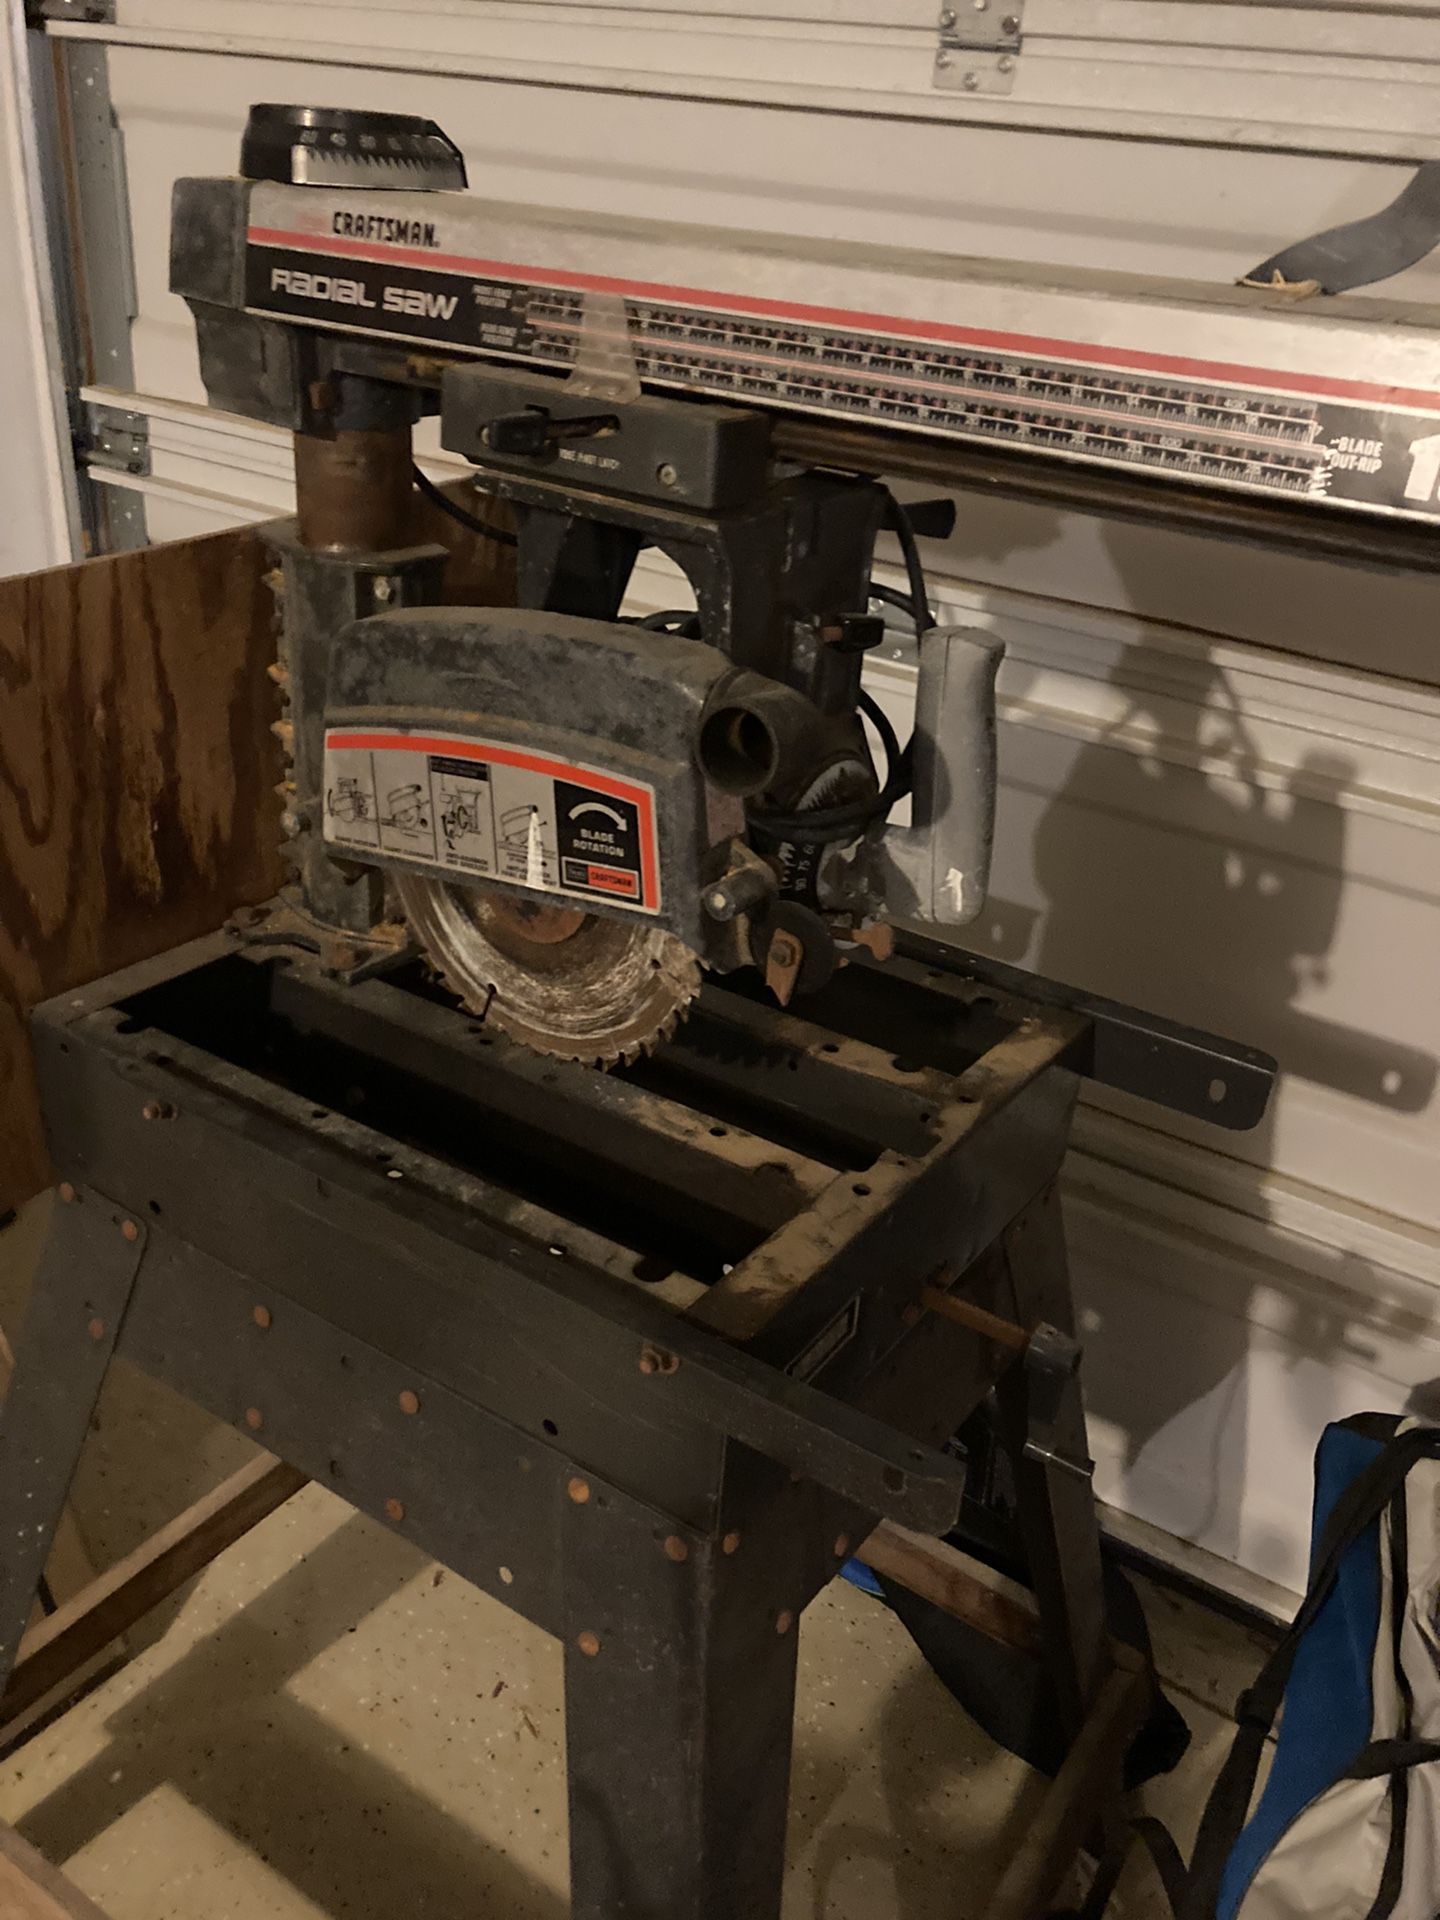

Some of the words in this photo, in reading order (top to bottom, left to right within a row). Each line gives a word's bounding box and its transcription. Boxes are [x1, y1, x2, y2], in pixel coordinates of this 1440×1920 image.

[1337, 435, 1384, 458] BLADE
[1330, 453, 1383, 475] OUT-RIP
[580, 828, 615, 844] BLADE
[572, 838, 625, 858] ROTATION
